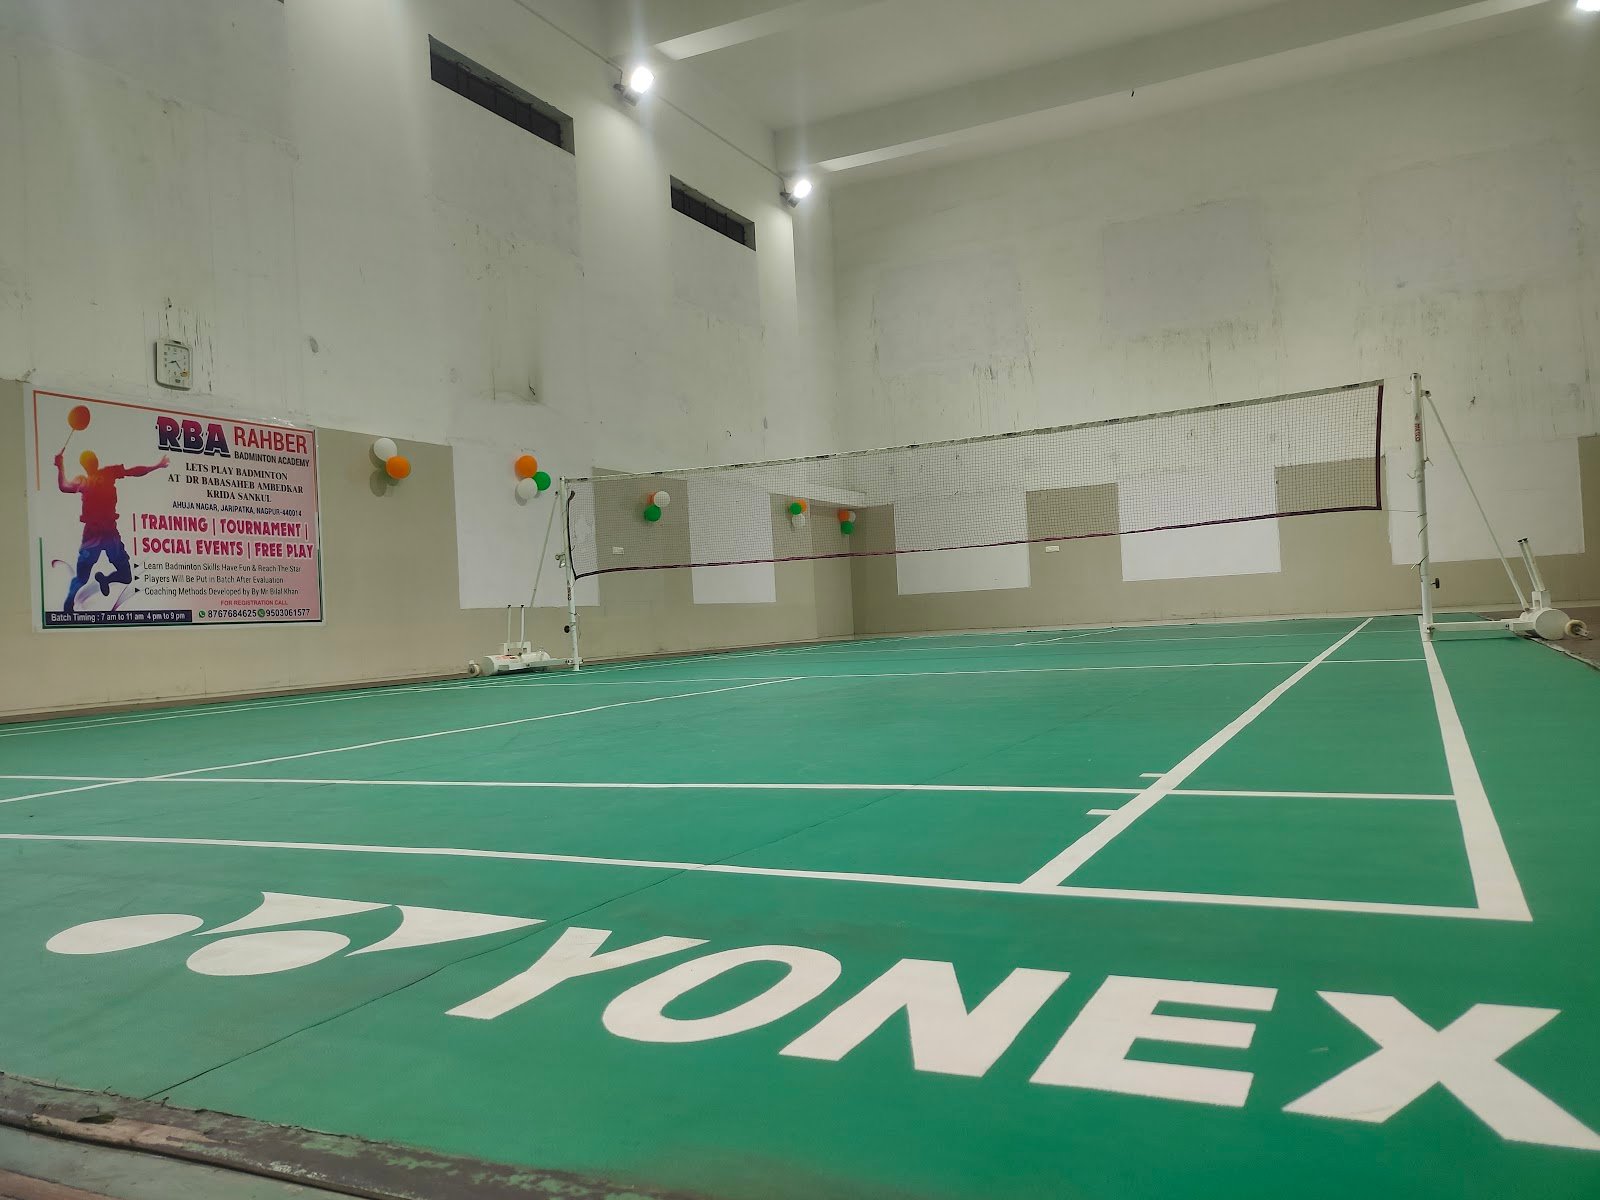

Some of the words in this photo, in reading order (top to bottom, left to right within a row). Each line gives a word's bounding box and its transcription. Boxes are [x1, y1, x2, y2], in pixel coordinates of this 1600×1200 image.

[156, 416, 230, 457] RBA
[234, 426, 307, 454] RAHBER
[234, 451, 276, 463] BADMINTON
[278, 456, 309, 467] ACADEMY
[186, 463, 208, 472] LETS
[211, 465, 233, 475] PLAY
[236, 468, 287, 480] BADMINTON
[168, 474, 181, 482] AT
[186, 475, 199, 484] DR
[202, 477, 255, 489] BABASAHEB
[258, 482, 303, 494] AMBEDKAR
[207, 490, 235, 499] KRIDA
[238, 492, 271, 502] SANKUL
[196, 503, 219, 512] NAGAR,
[221, 505, 255, 514] JARIPATKA,
[256, 507, 302, 516] NAGPUR-440014
[141, 514, 208, 532] TRAINING
[220, 518, 301, 537] TOURNAMENT
[142, 538, 191, 554] SOCIAL
[196, 540, 244, 556] EVENTS
[255, 542, 283, 557] FREE
[286, 544, 313, 558] PLAY
[144, 562, 164, 570] Learn
[165, 562, 201, 570] Badminton
[203, 562, 220, 571] Skills
[144, 574, 170, 584] Players
[144, 588, 176, 597] Coaching
[178, 588, 206, 596] Methods
[208, 588, 241, 596] Developed
[242, 588, 250, 596] by
[252, 588, 258, 596] By
[51, 614, 72, 622] Batch
[73, 612, 96, 622] Timing
[152, 613, 162, 621] pm
[208, 610, 256, 618] 8767684625
[266, 608, 310, 616] 9503061577
[446, 926, 1600, 1151] YONEX
